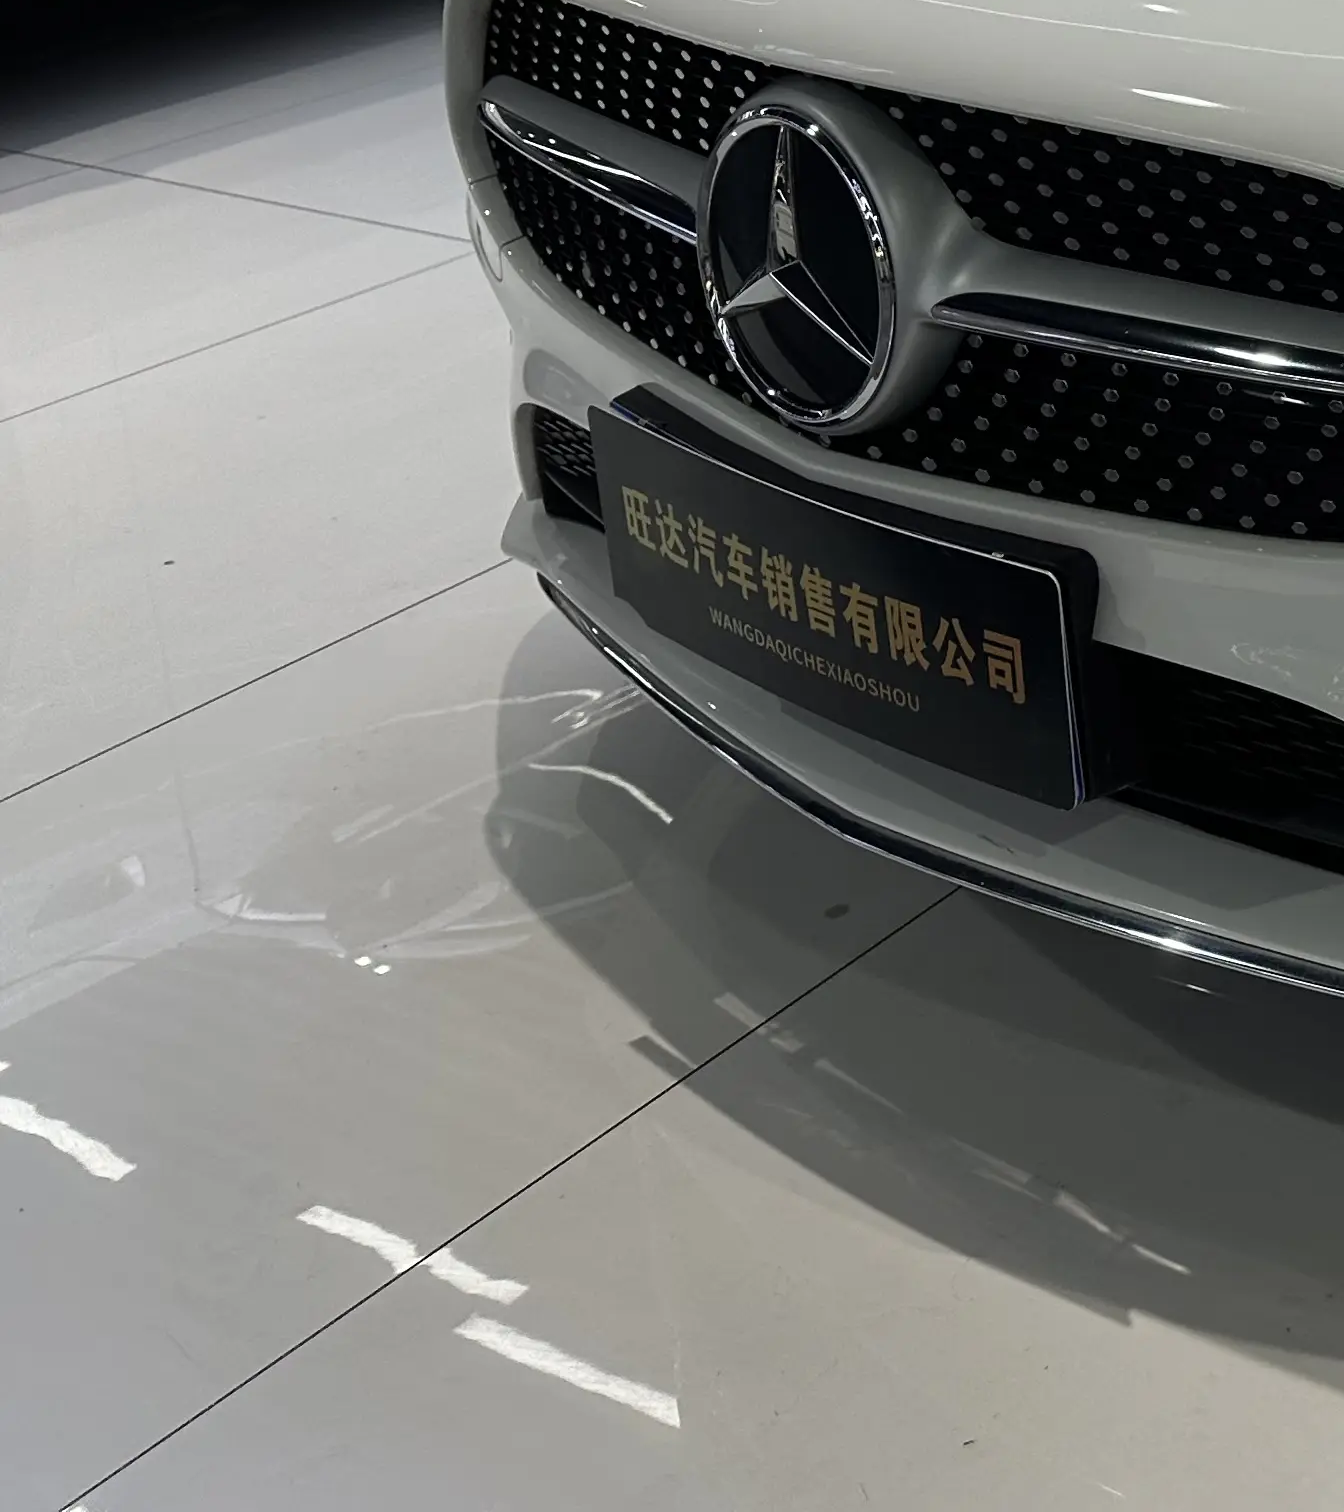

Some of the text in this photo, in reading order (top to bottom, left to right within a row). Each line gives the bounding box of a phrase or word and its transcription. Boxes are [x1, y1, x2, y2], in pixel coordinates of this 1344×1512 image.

[621, 485, 1026, 705] 旺达汽车销售有限公司
[708, 605, 920, 713] WANGDAQICHEXIAOSHOU
